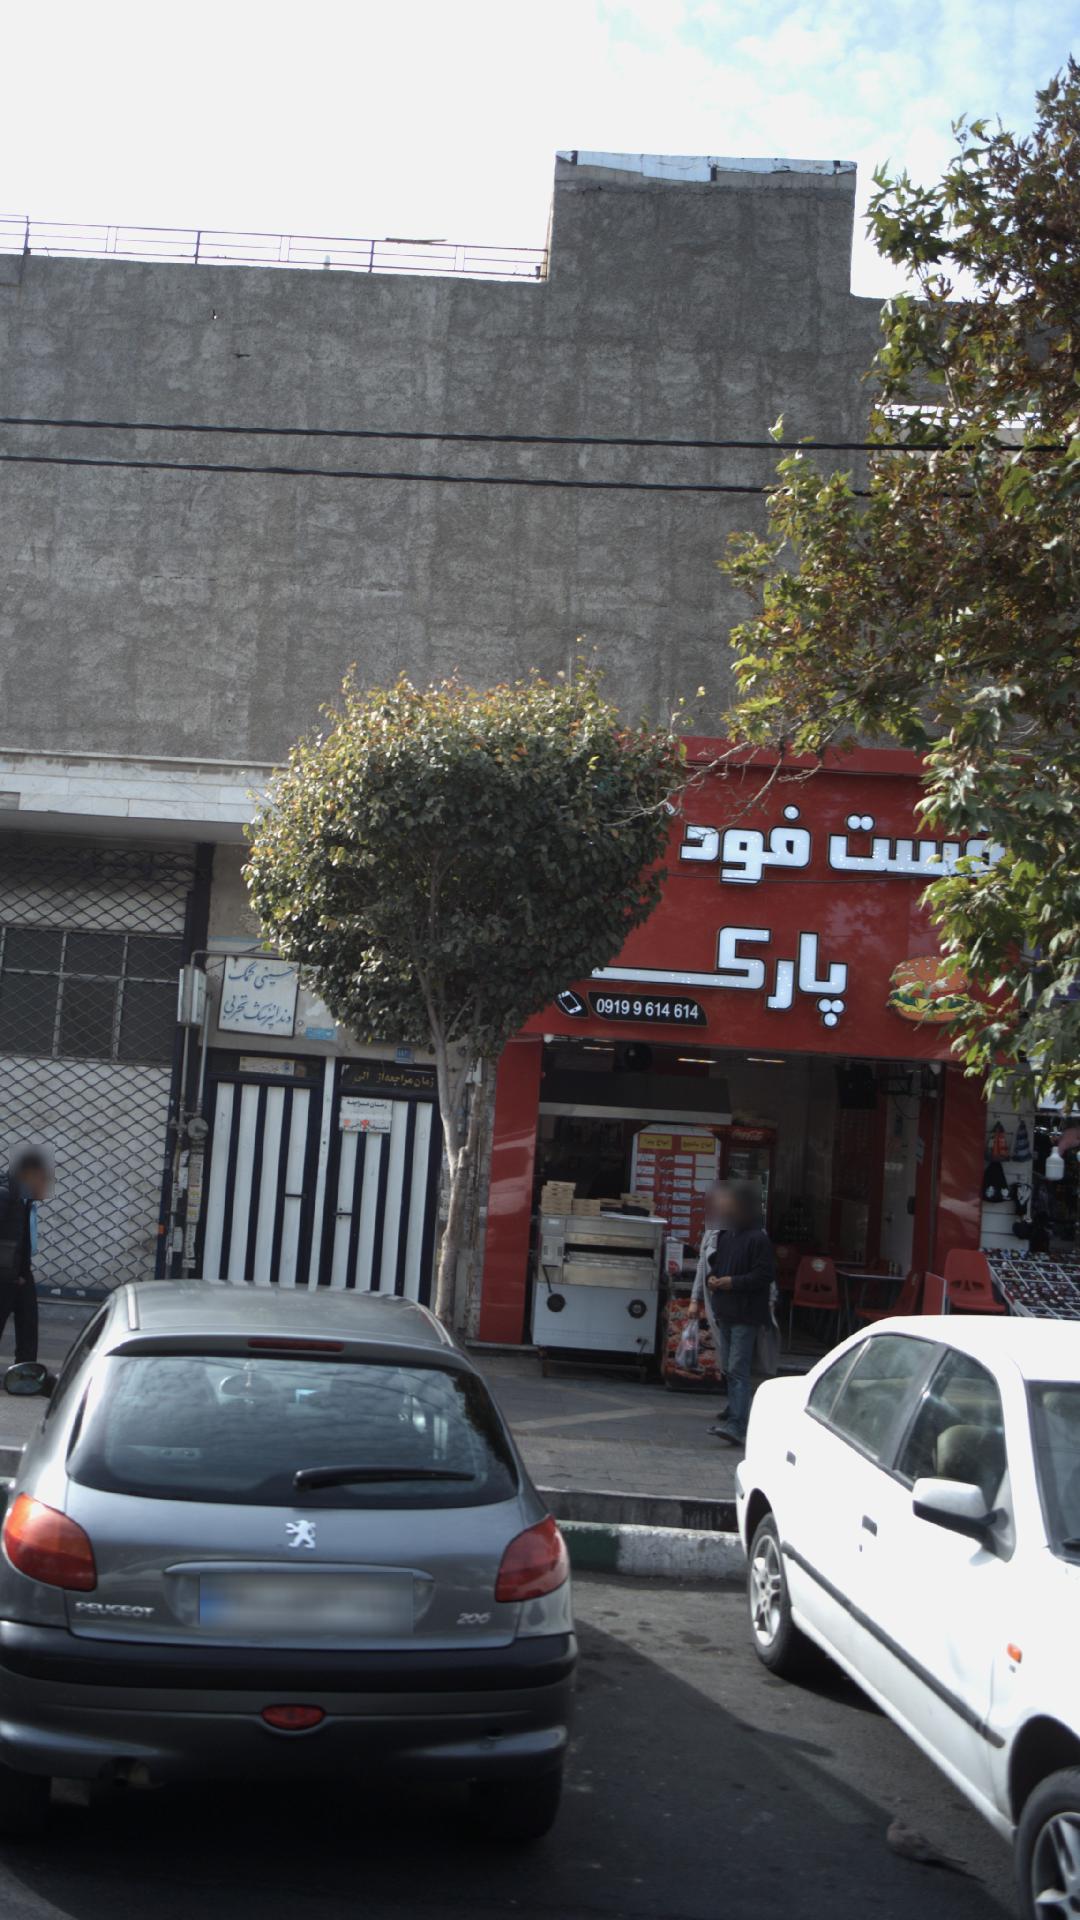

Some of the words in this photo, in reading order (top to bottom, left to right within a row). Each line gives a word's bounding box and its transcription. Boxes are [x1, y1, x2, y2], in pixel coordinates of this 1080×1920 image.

[680, 803, 812, 886] فود
[253, 964, 298, 990] حسینی
[590, 925, 849, 1028] پارک
[222, 994, 249, 1022] تجربی
[243, 1001, 292, 1030] دندانپزشک
[596, 998, 631, 1015] 0919
[633, 1000, 642, 1016] 9
[645, 1001, 670, 1017] 614
[674, 1003, 699, 1019] 614
[385, 1074, 414, 1087] مراجعه
[414, 1077, 434, 1089] زمان
[75, 1602, 155, 1618] PEUGEOT
[456, 1612, 491, 1625] 206
